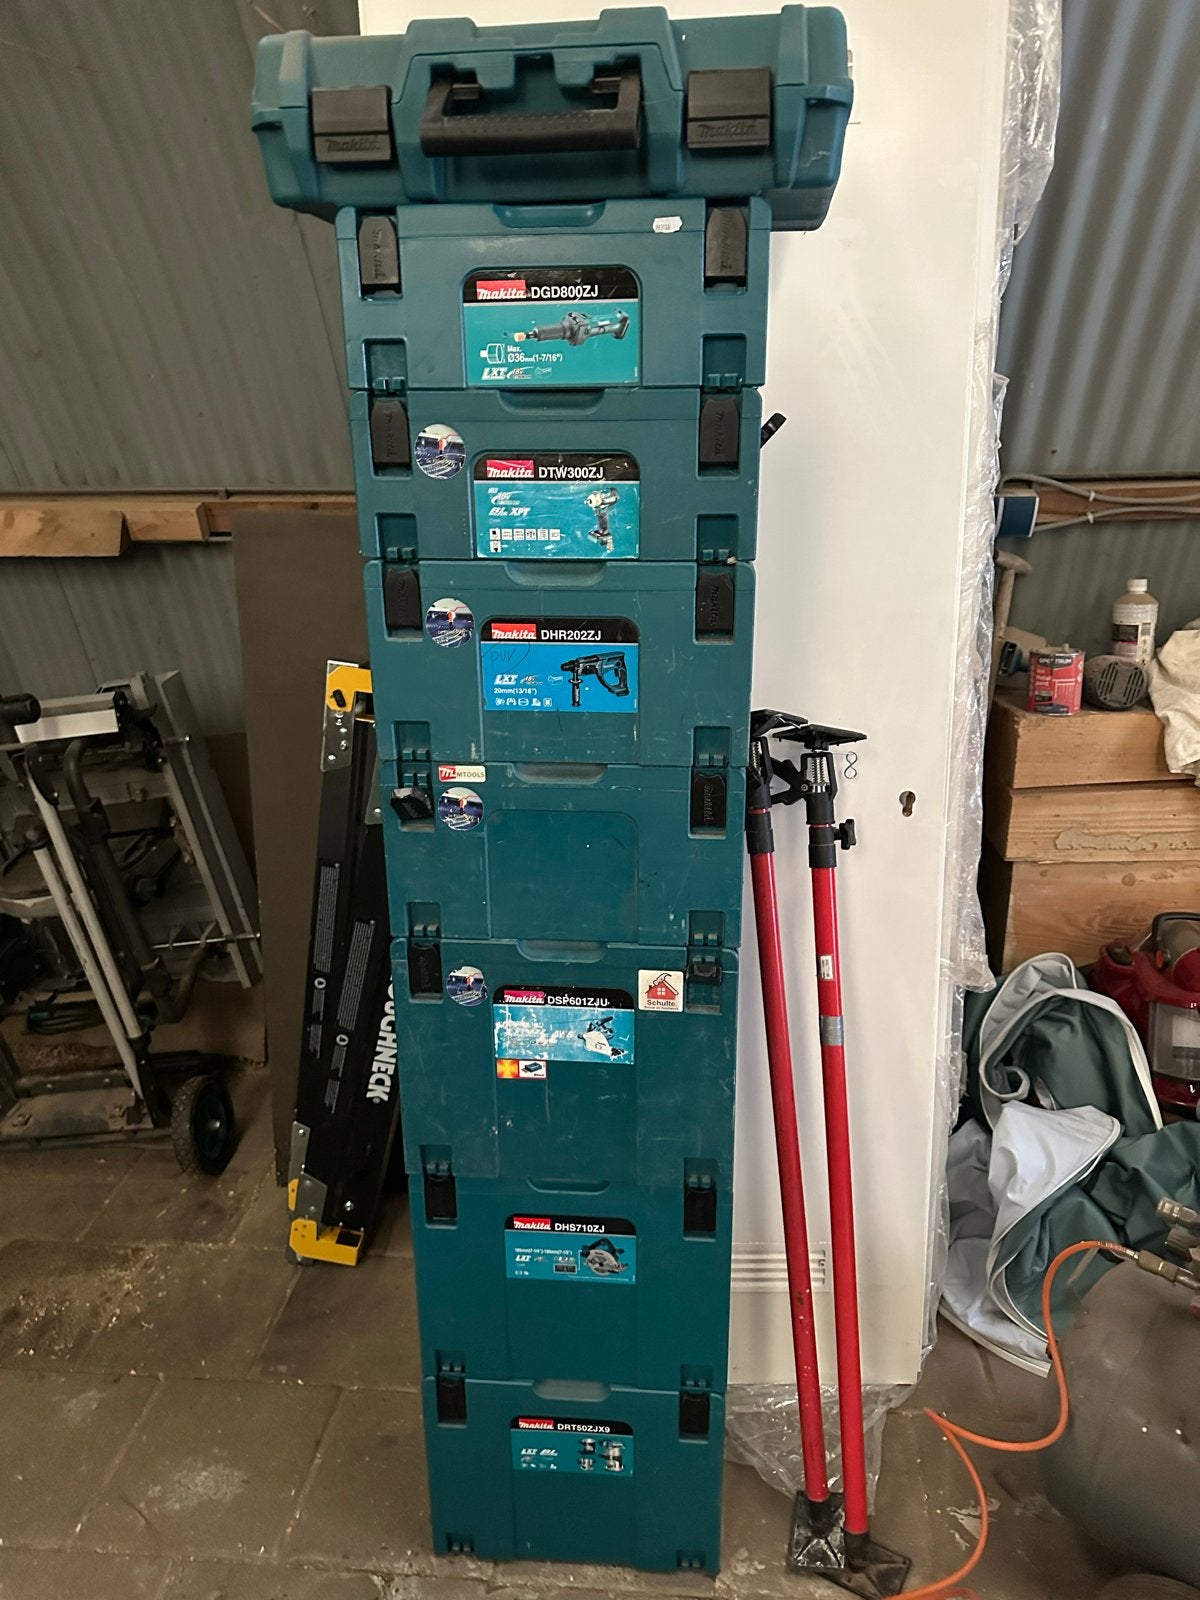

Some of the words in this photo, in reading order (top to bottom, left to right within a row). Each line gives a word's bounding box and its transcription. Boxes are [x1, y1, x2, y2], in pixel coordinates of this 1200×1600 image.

[531, 285, 598, 299] DGD800ZJ
[482, 367, 508, 380] LXT
[538, 466, 604, 479] DTW300ZJ
[541, 629, 602, 641] DHR202ZJ
[494, 674, 518, 685] LXT
[547, 996, 608, 1007] DSP601ZJU
[554, 1223, 605, 1233] DHS710ZJ
[557, 1423, 610, 1433] DRT50ZJX9
